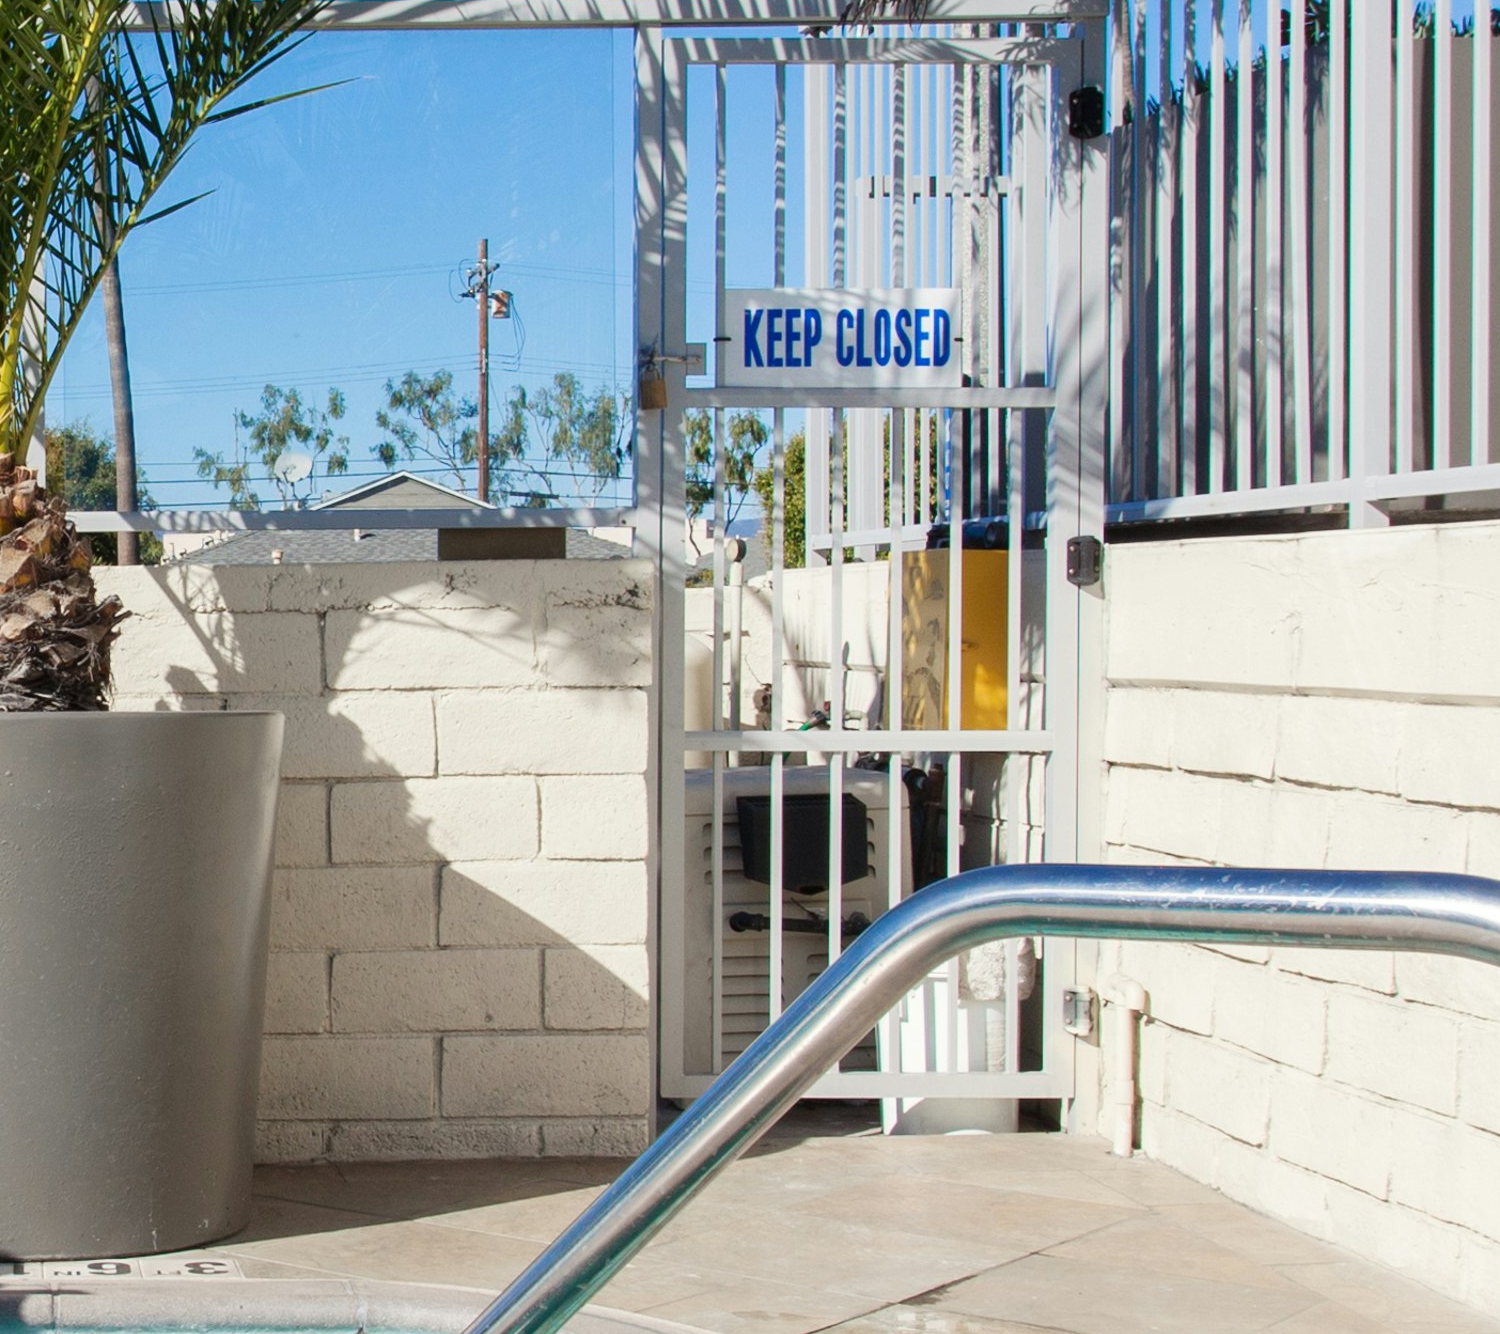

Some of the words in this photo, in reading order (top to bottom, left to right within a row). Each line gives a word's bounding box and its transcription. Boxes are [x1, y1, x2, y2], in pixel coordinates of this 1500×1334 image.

[744, 308, 822, 367] KEEP
[836, 308, 951, 367] CLOSED
[184, 1261, 230, 1275] 3
